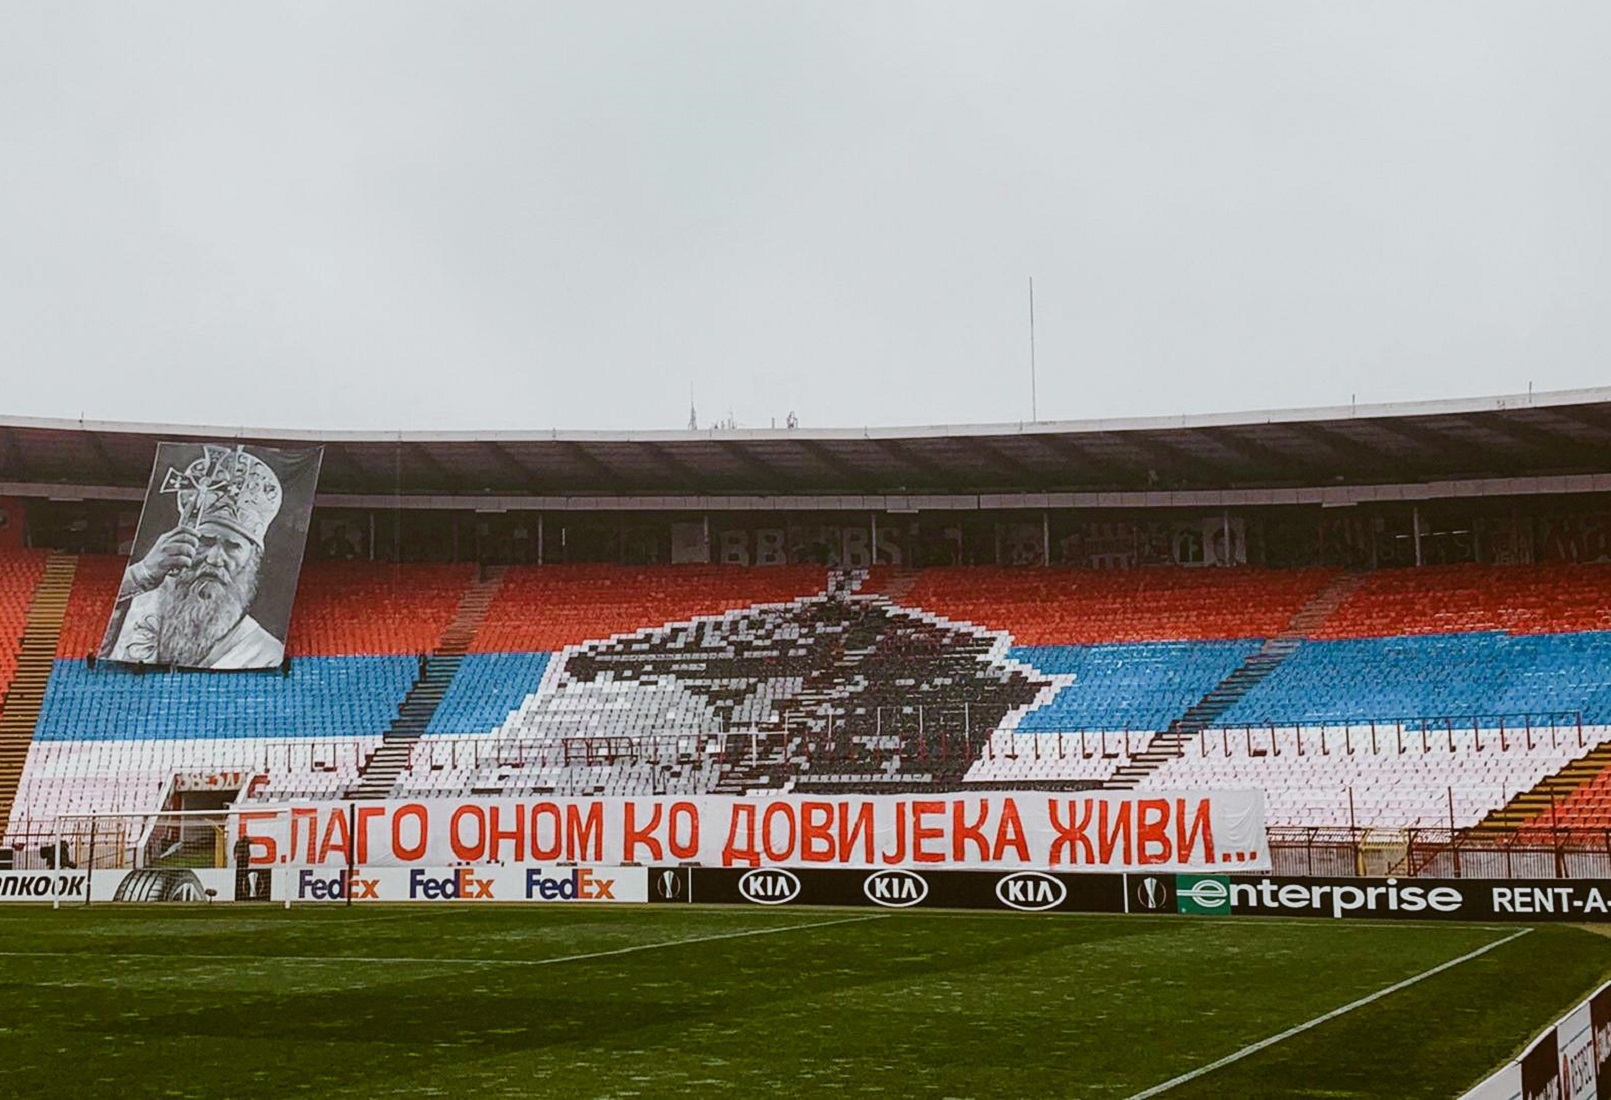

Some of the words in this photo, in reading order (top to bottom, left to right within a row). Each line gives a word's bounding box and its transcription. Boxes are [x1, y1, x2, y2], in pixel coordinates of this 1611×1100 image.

[450, 802, 603, 862] ОНОМ
[624, 802, 699, 861] КО
[722, 798, 1031, 867] ДОВИЈЕКА
[1048, 797, 1257, 866] ЖИВИ...
[298, 868, 381, 899] FedEx
[409, 868, 495, 899] FedEx
[525, 867, 616, 900] FedEx
[748, 875, 791, 897] KIA
[874, 877, 918, 899] KIA
[1008, 880, 1054, 902] KIA
[1190, 878, 1463, 919] enterprise
